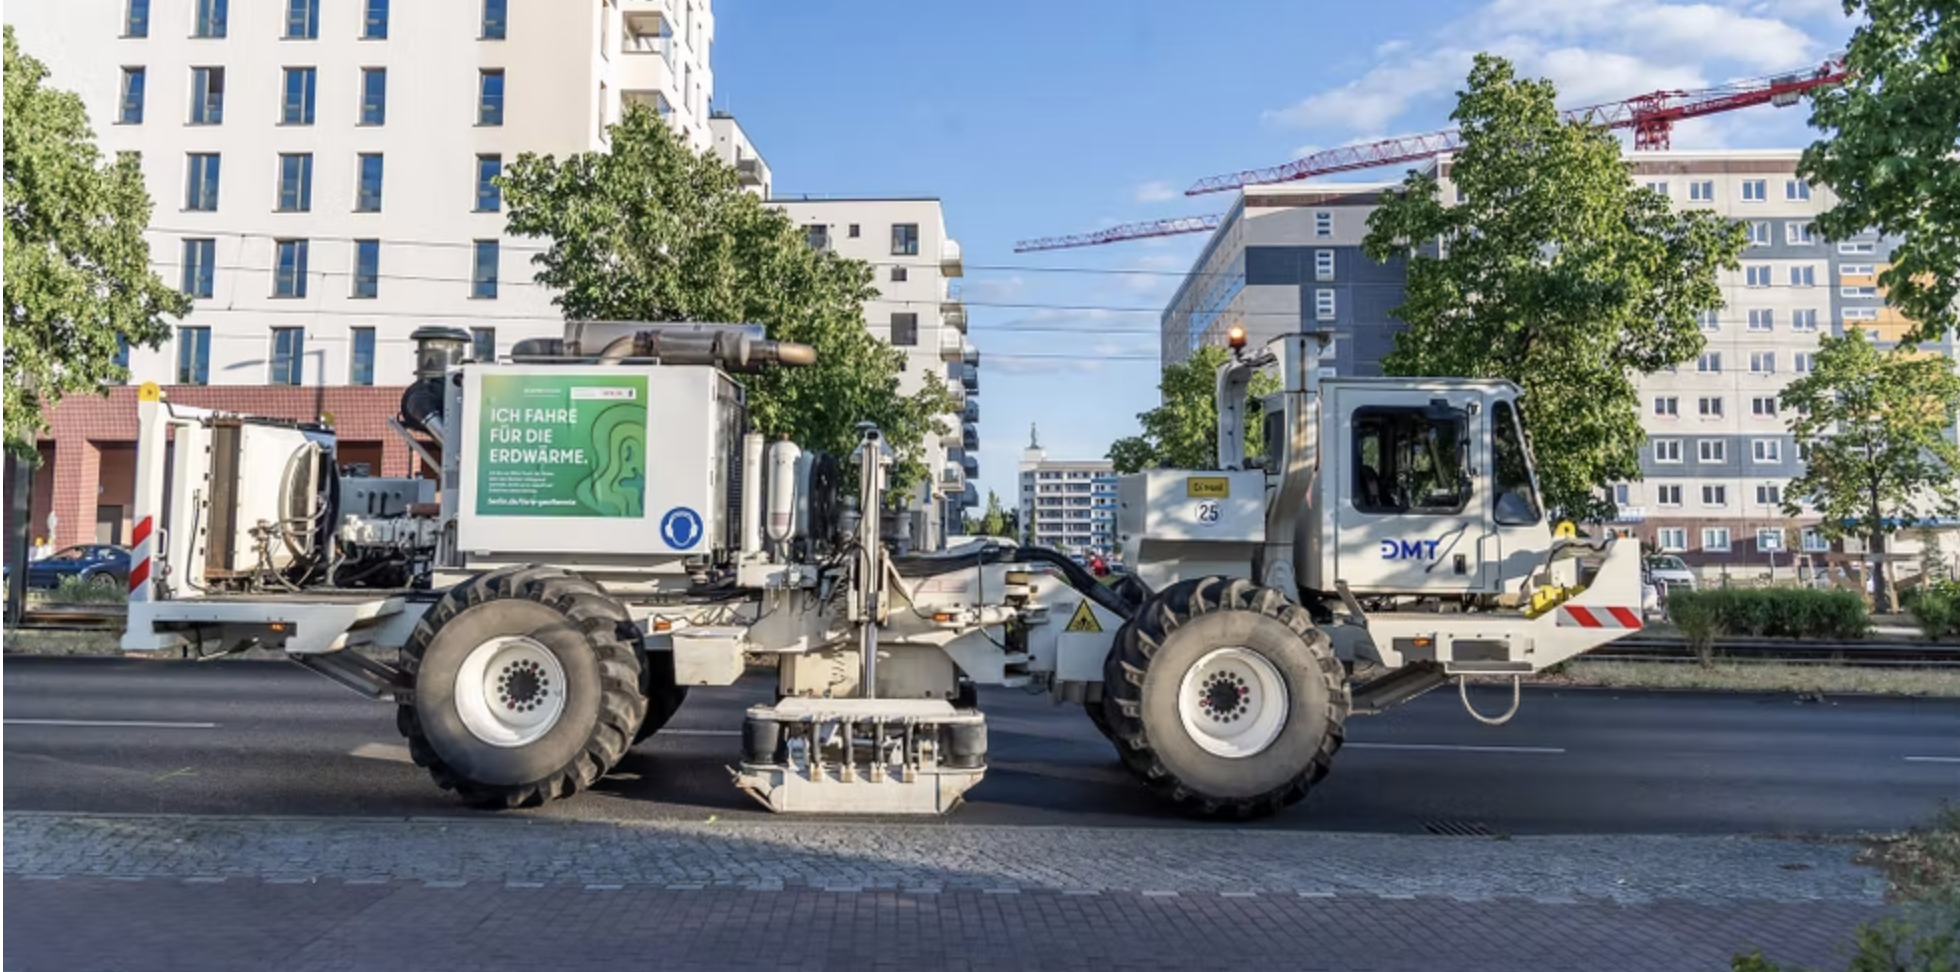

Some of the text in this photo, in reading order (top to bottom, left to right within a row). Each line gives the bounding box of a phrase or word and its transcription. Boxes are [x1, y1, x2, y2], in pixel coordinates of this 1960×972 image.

[490, 408, 578, 424] ICH FAHRE
[490, 424, 553, 444] FÜR DIE
[490, 444, 588, 464] ERDWÄRME.
[1200, 504, 1219, 521] 25
[1381, 540, 1440, 560] DMT
